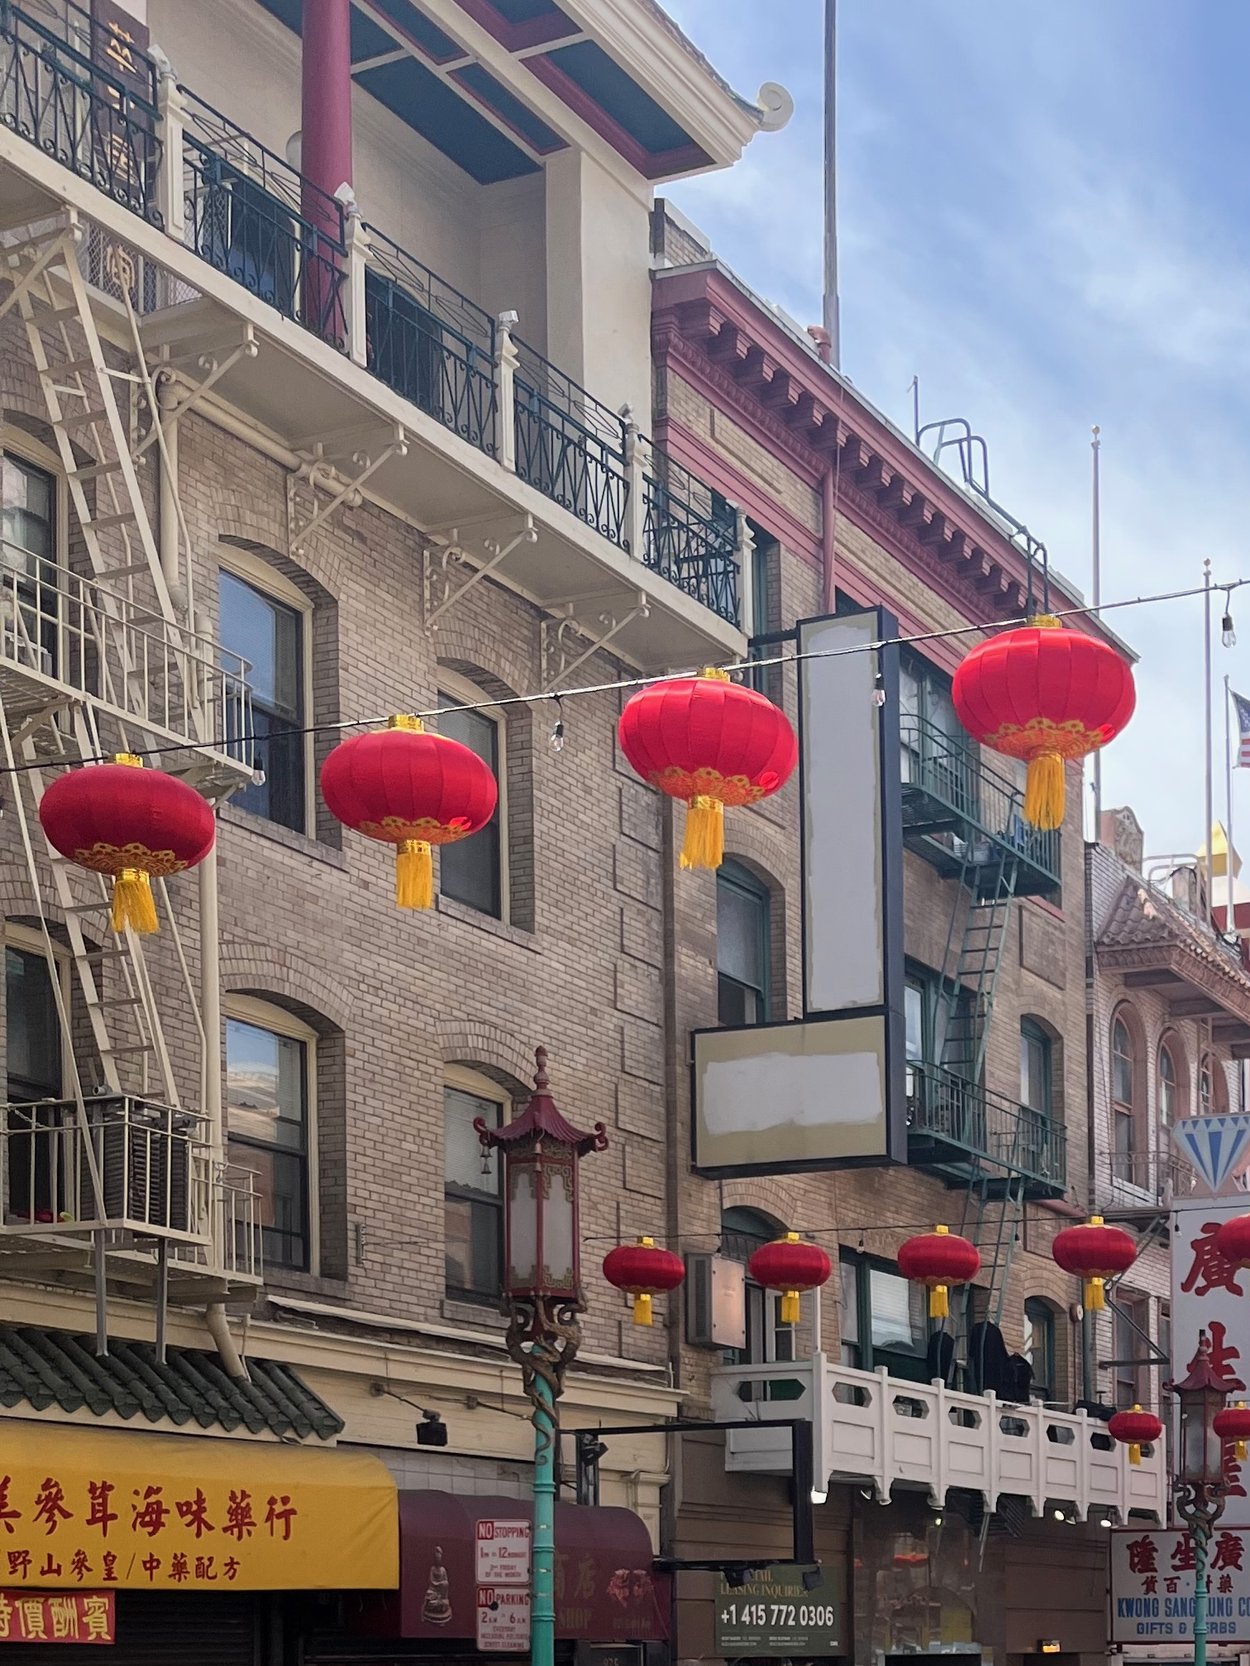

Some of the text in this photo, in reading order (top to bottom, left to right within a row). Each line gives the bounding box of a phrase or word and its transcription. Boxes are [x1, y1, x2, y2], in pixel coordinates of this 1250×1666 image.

[478, 1522, 530, 1539] NO STOPPING
[478, 1589, 529, 1606] NO PARKING
[741, 1604, 766, 1626] 415
[770, 1604, 796, 1626] 772
[800, 1605, 834, 1626] 0306
[1117, 1597, 1159, 1618] KWONG
[1136, 1622, 1173, 1635] GIFTS
[1178, 1622, 1187, 1634] &
